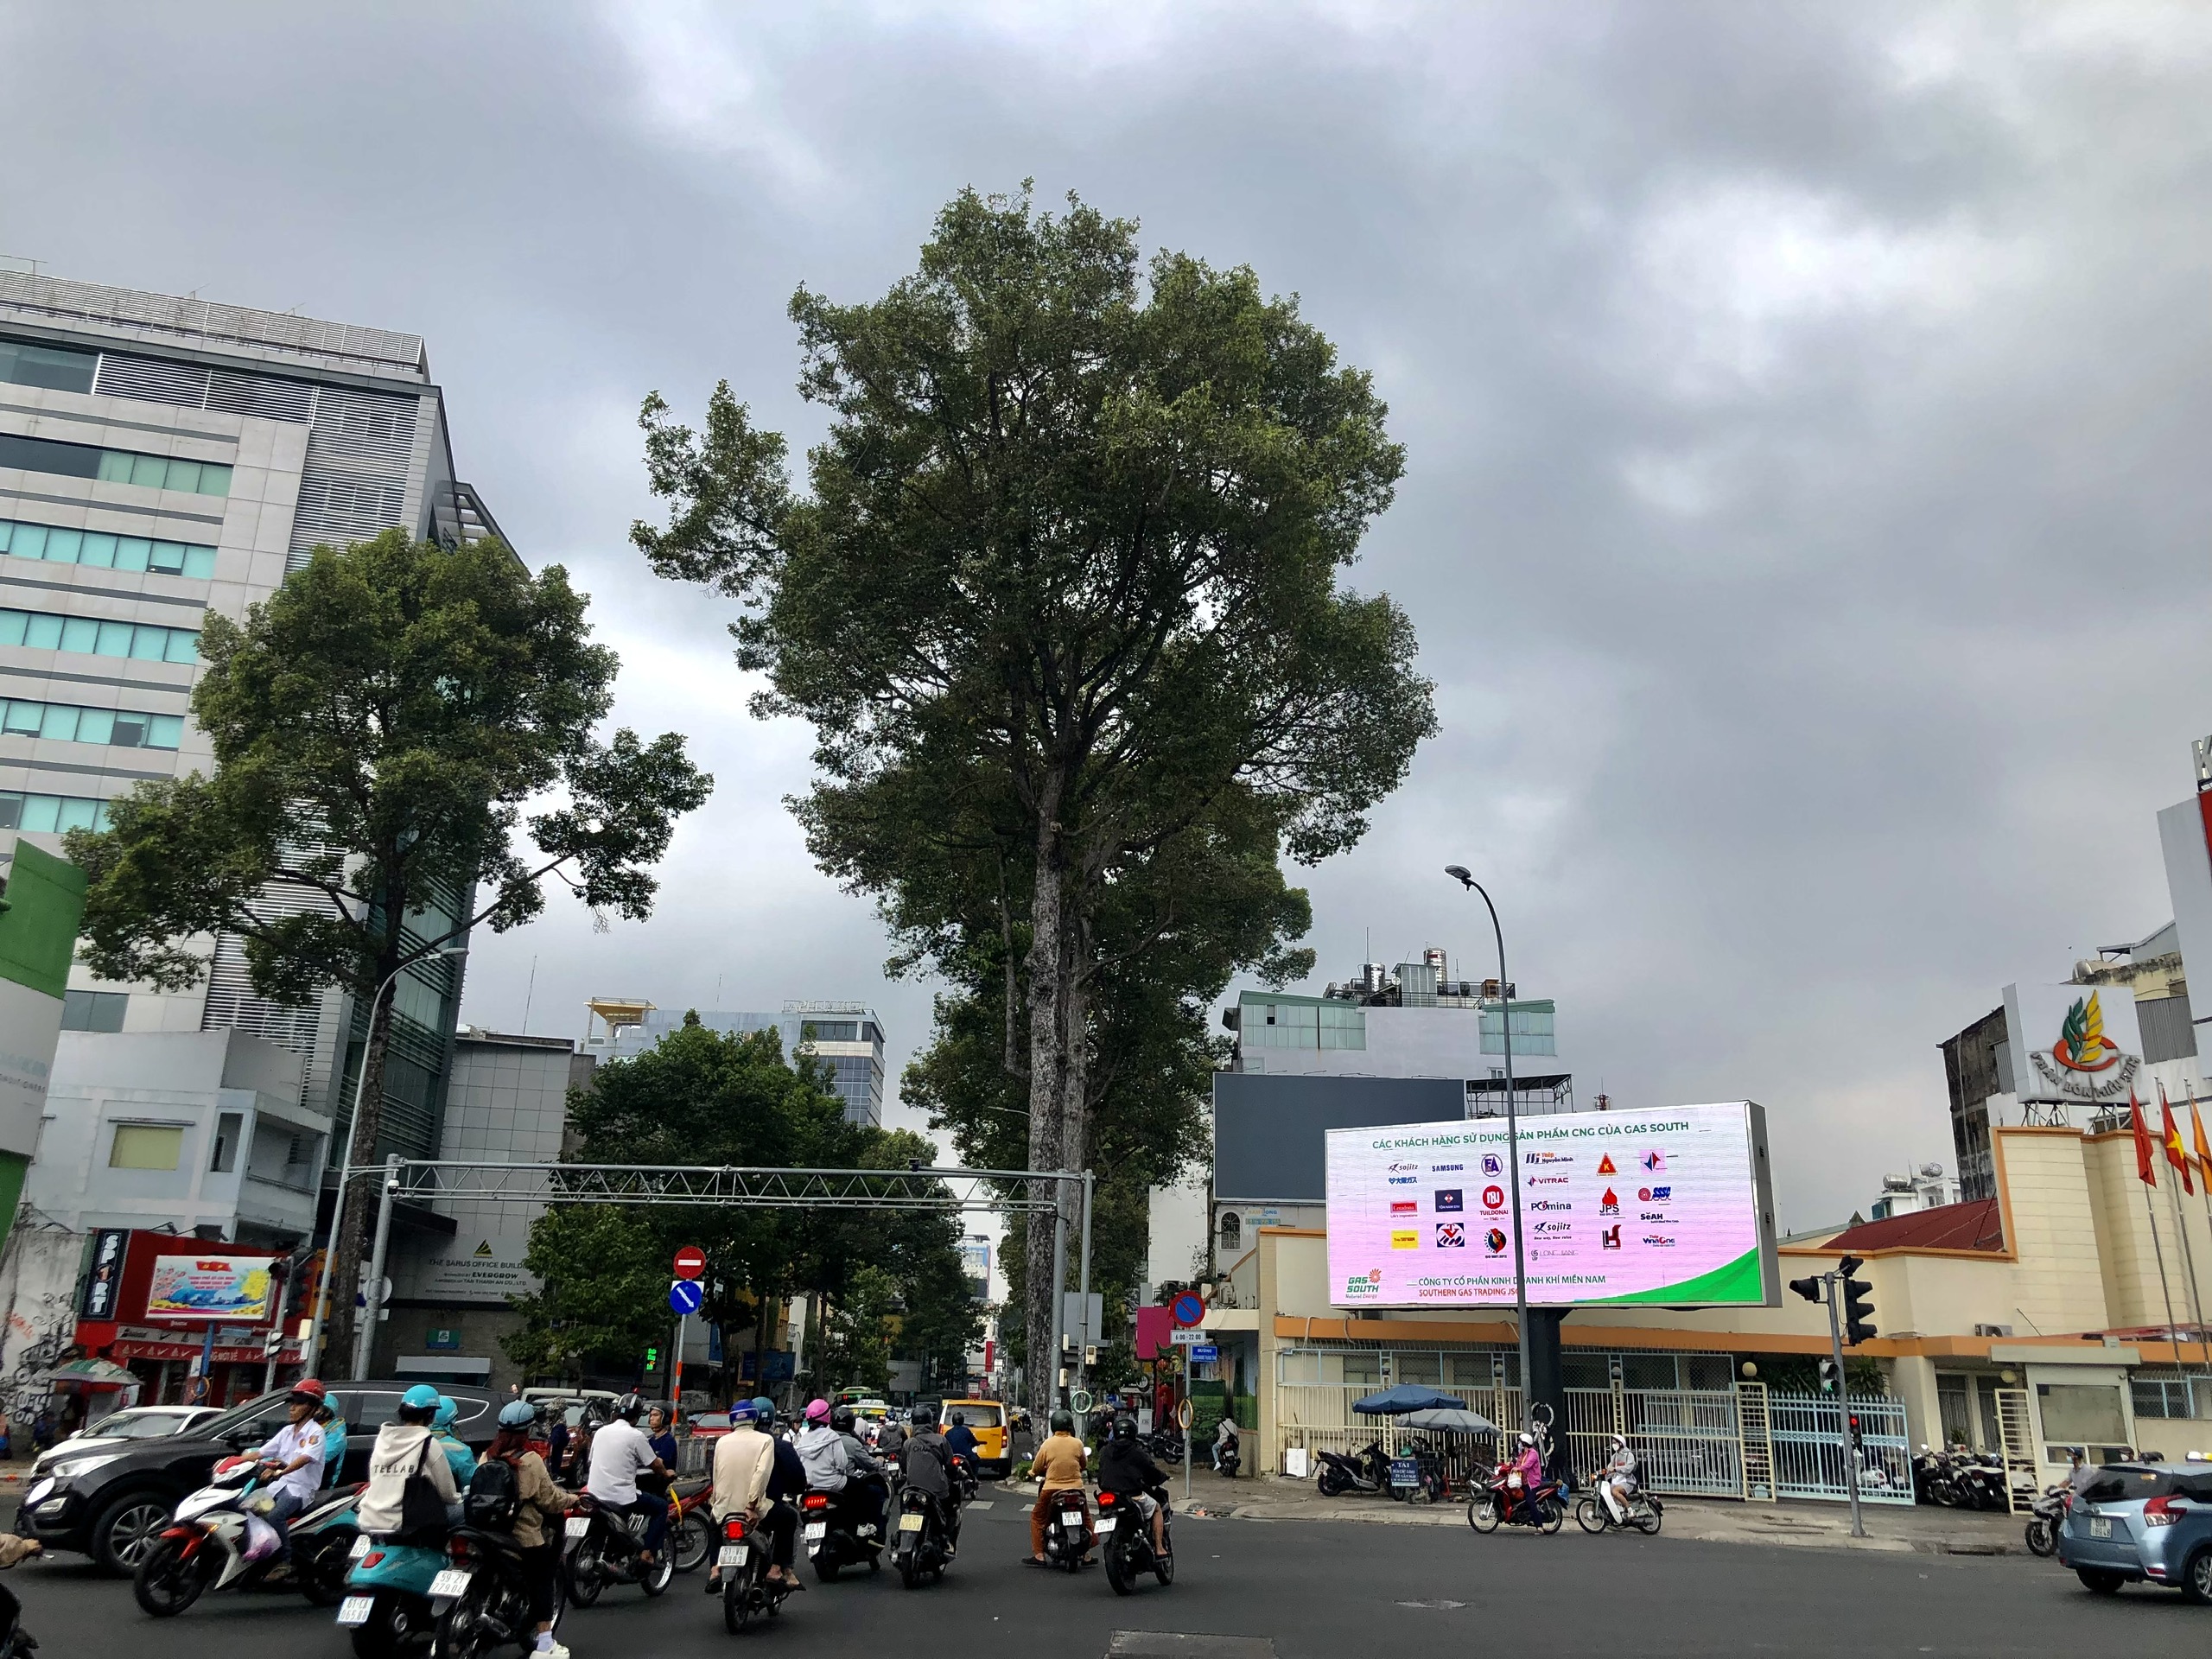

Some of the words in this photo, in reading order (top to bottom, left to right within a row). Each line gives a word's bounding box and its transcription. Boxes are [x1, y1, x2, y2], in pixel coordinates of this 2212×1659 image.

[1372, 1138, 1391, 1149] CÁC
[1395, 1136, 1429, 1147] KHÁCH
[1432, 1135, 1460, 1146] HÀNG
[1463, 1132, 1477, 1143] SỬ
[1479, 1133, 1510, 1145] DỤNG
[1537, 1127, 1569, 1139] PHẨM
[1572, 1128, 1595, 1137] CNG
[1599, 1124, 1621, 1135] CỦA
[1624, 1124, 1648, 1134] GAS
[1650, 1122, 1689, 1132] SOUTH
[1399, 1163, 1419, 1172] sojitz
[1599, 1205, 1619, 1213] JPS
[1548, 1223, 1571, 1231] sojitz
[1454, 1275, 1465, 1285] CỔ
[1467, 1275, 1489, 1285] PHẦN
[1546, 1275, 1560, 1284] KHÍ
[1562, 1274, 1583, 1284] MIỀN
